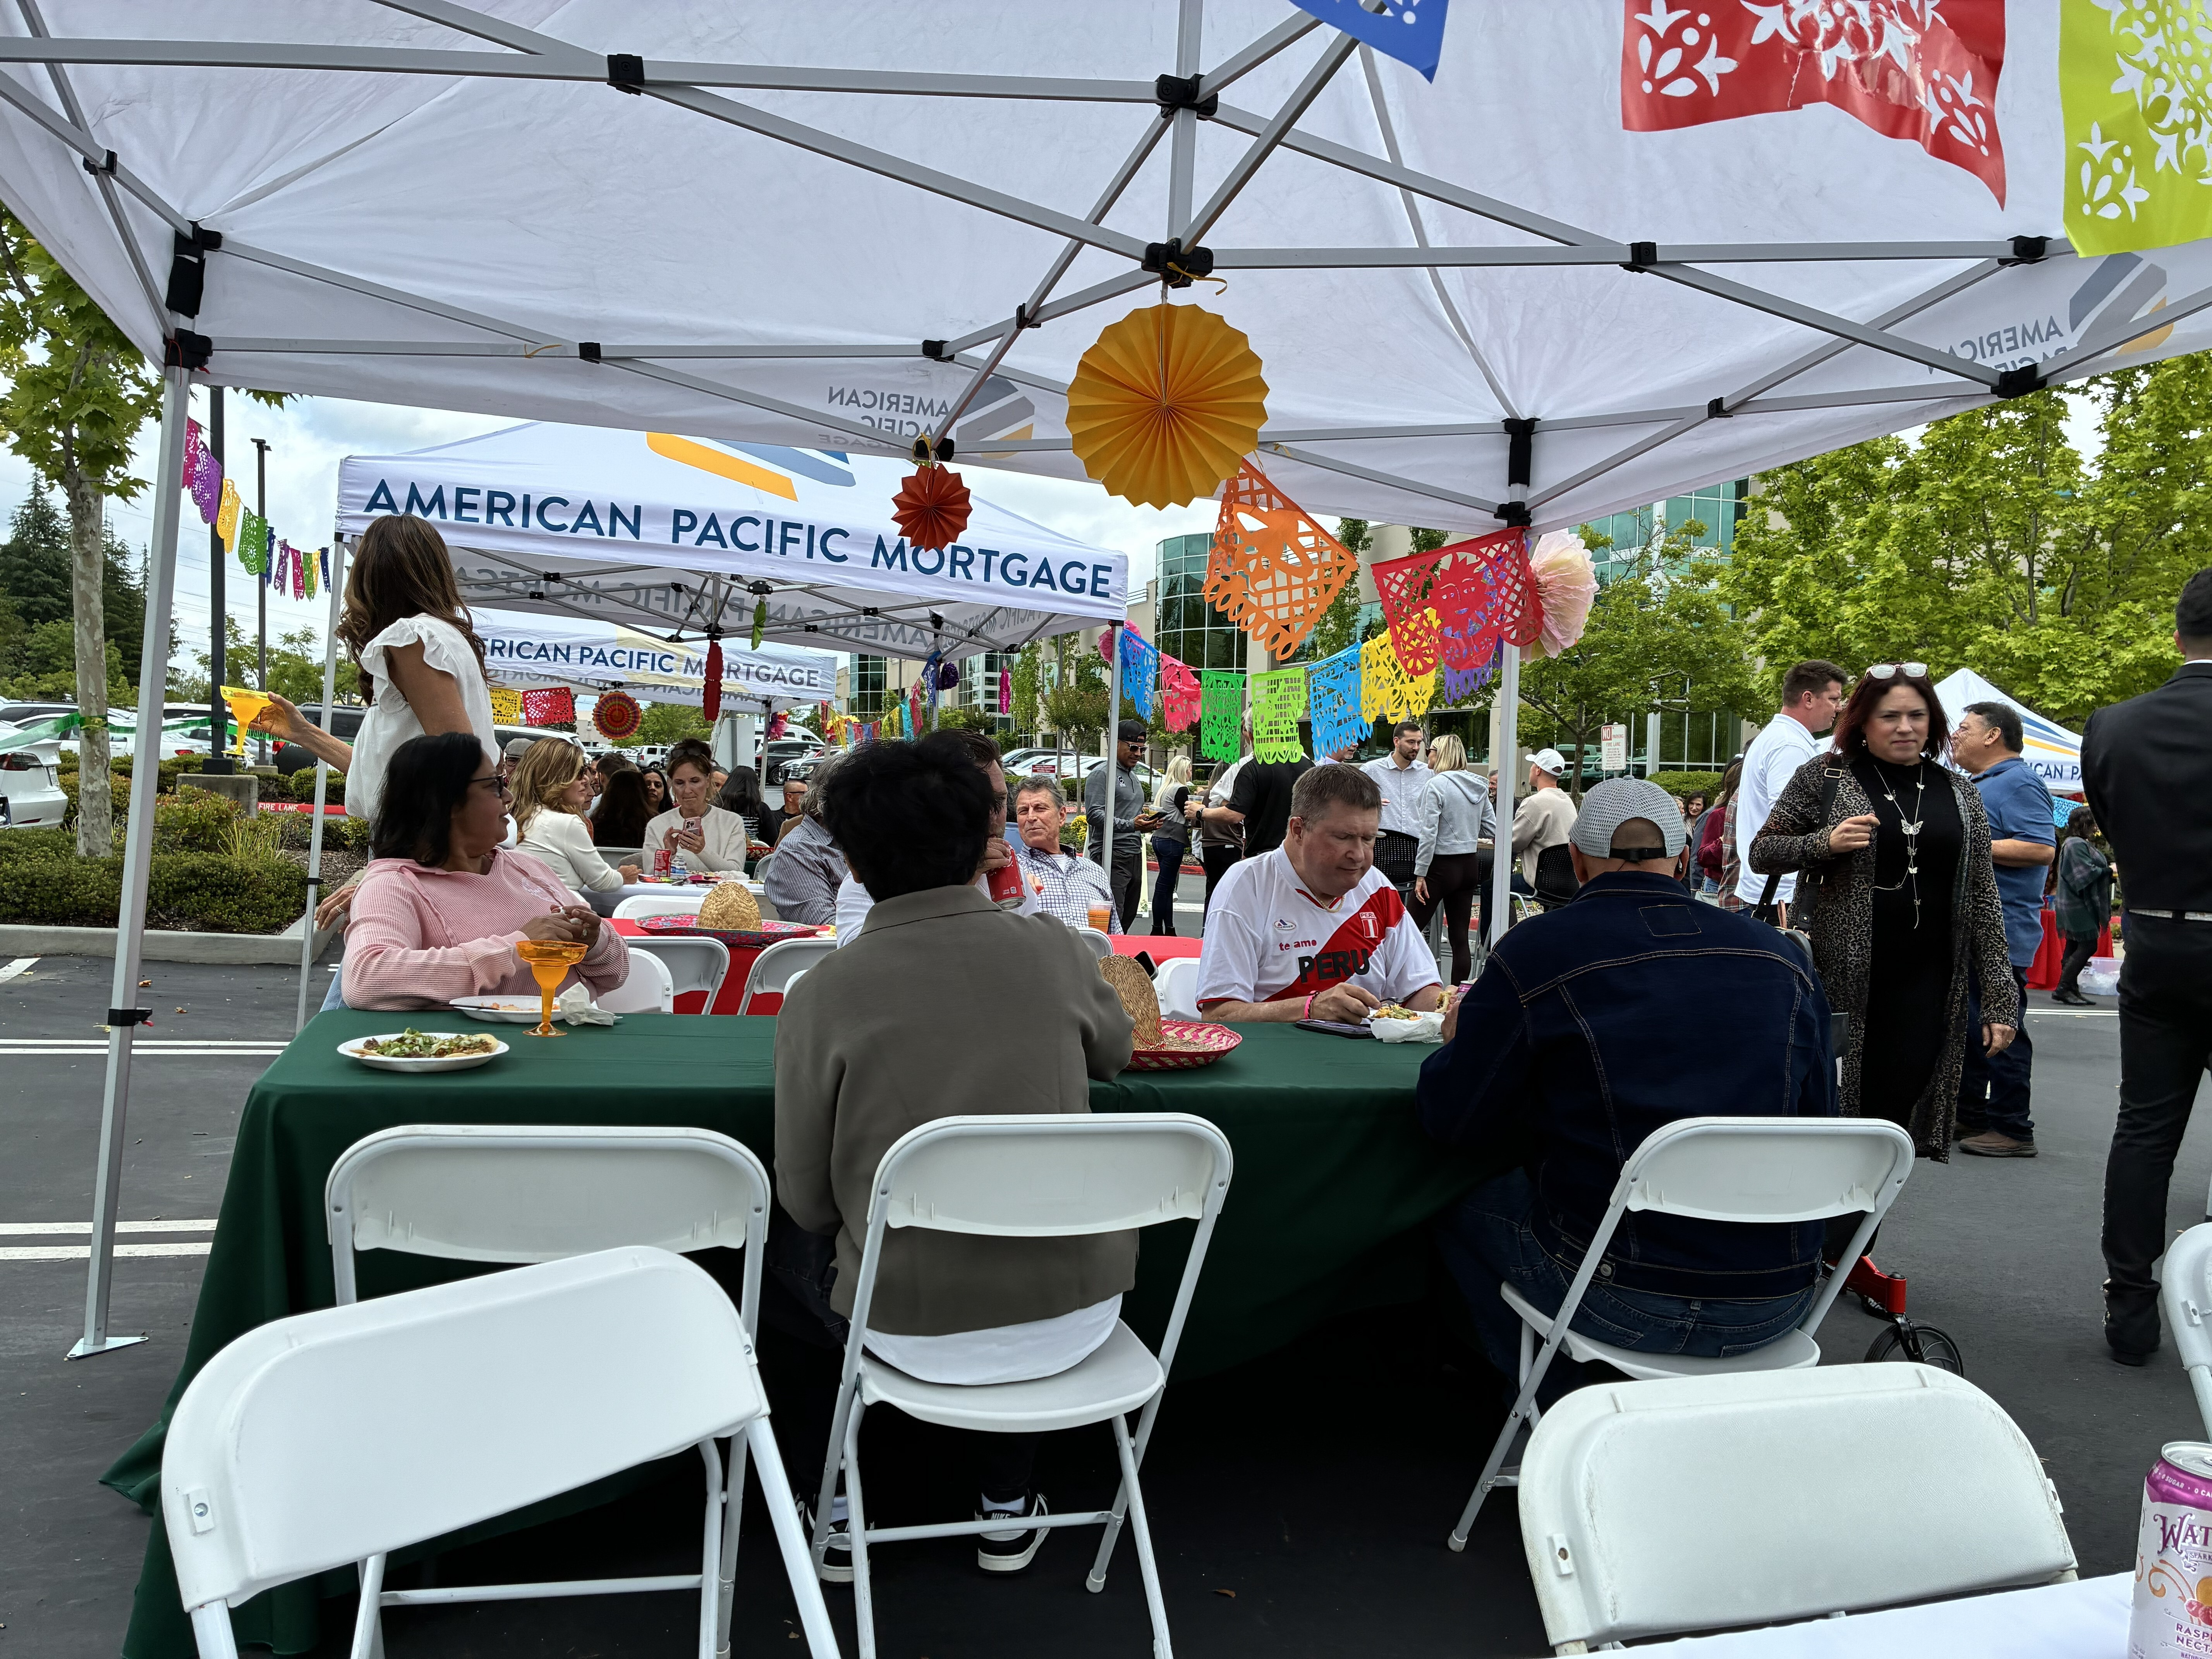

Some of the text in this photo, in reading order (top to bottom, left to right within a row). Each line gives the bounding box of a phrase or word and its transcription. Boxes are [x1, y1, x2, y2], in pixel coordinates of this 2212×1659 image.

[363, 478, 1112, 598] AMERICAN PACIFIC MORTGAGE
[580, 646, 674, 673] PACIFIC
[684, 657, 819, 687] MRTGAGE
[1603, 728, 1611, 740] NO
[258, 803, 275, 812] FIRE
[1279, 939, 1317, 951] te amo
[1297, 948, 1370, 983] PERU
[2165, 1476, 2185, 1489] SUGAR
[2201, 1489, 2212, 1498] CA
[2176, 1623, 2212, 1642] RASP
